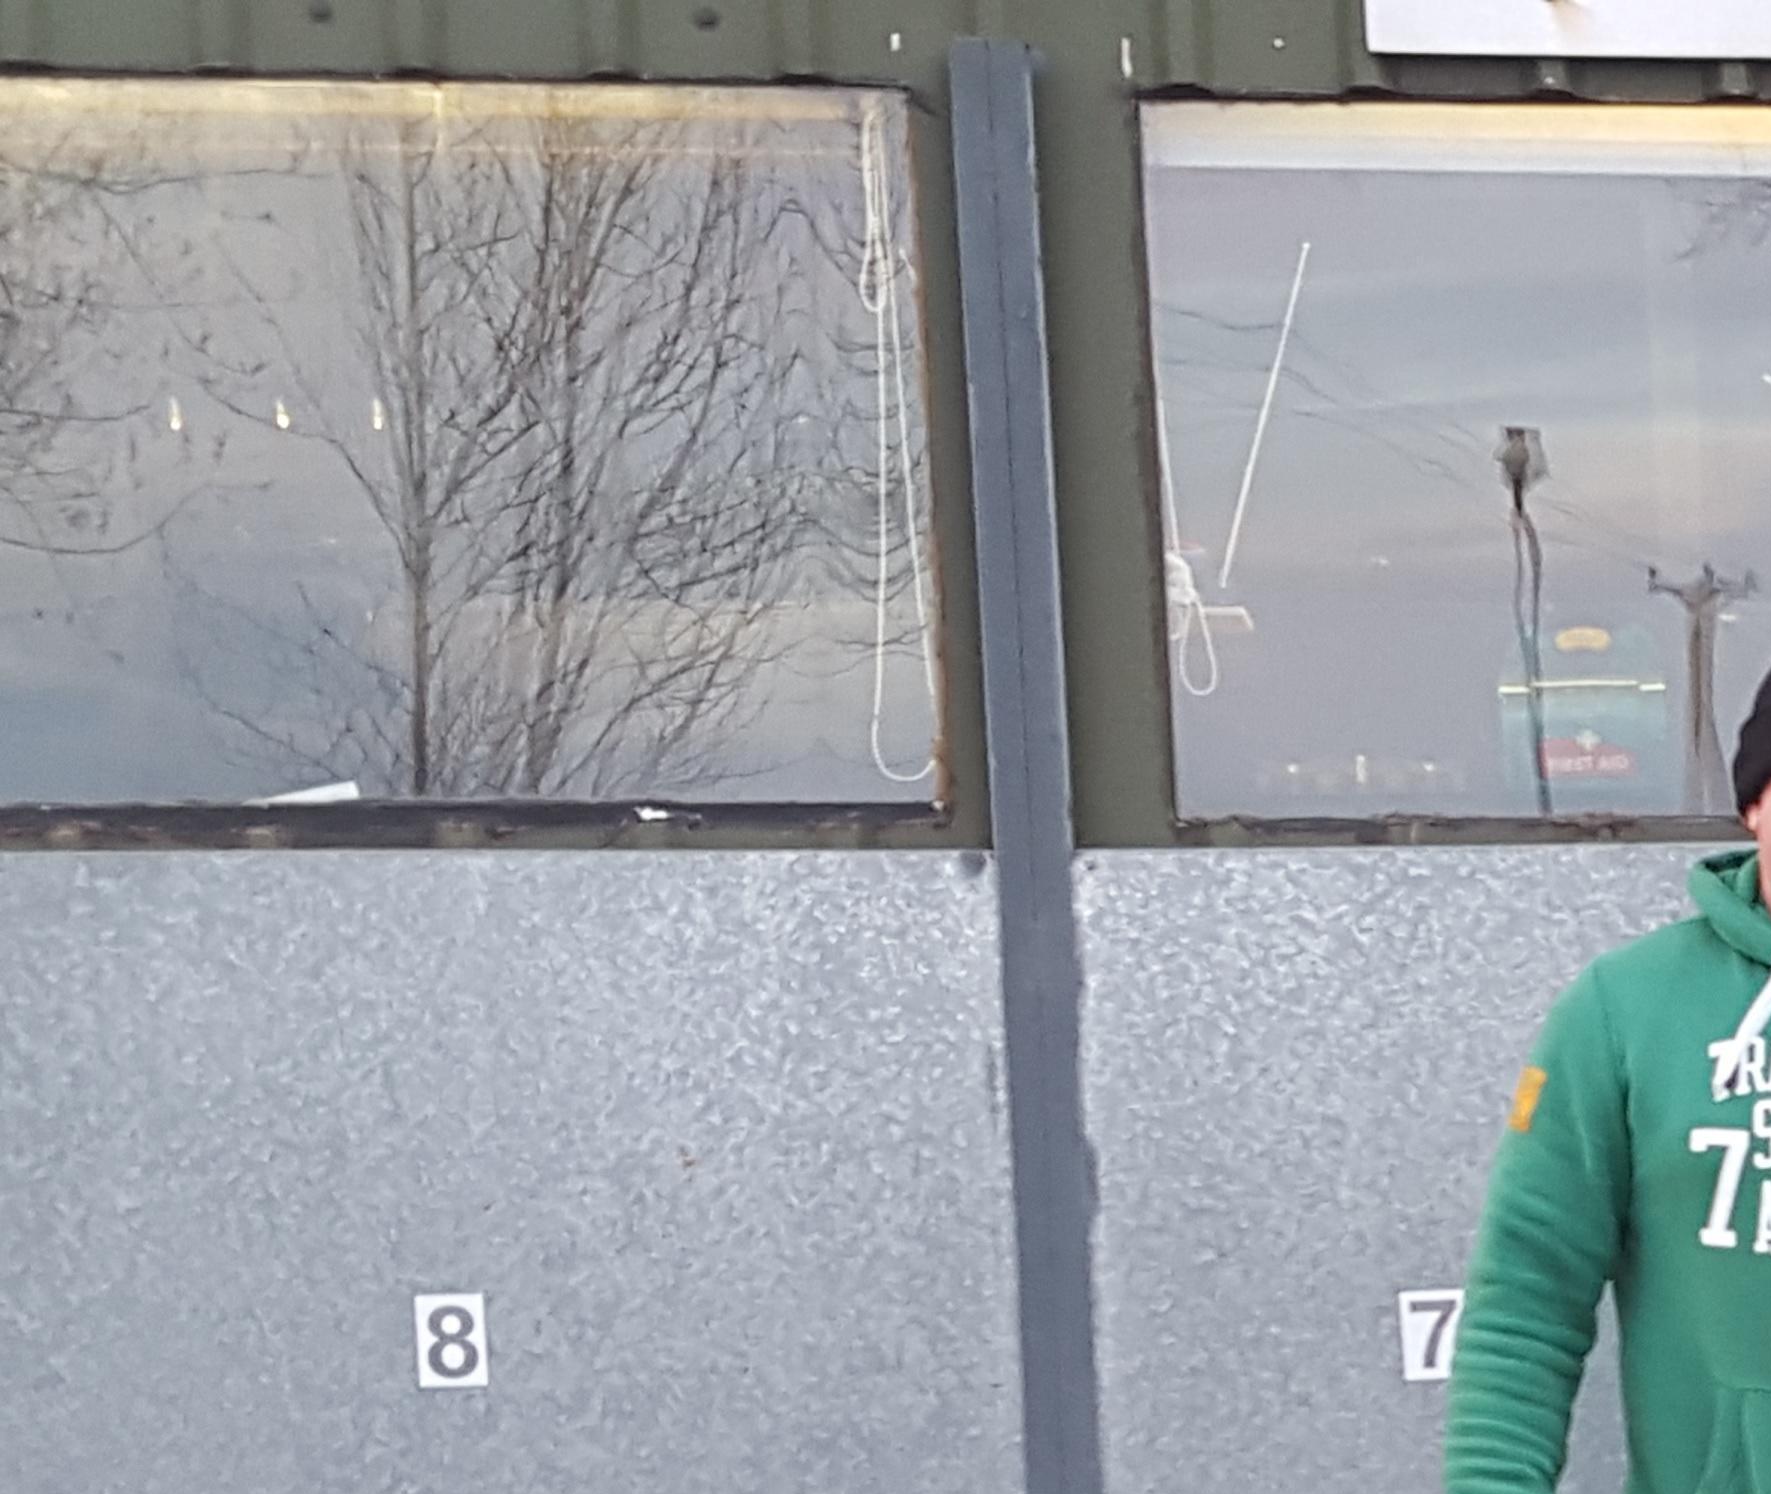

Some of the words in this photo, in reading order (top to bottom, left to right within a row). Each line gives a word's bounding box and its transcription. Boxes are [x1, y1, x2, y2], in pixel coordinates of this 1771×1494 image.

[1688, 1127, 1751, 1249] 7
[427, 1304, 479, 1379] 8
[1408, 1299, 1457, 1369] 7
